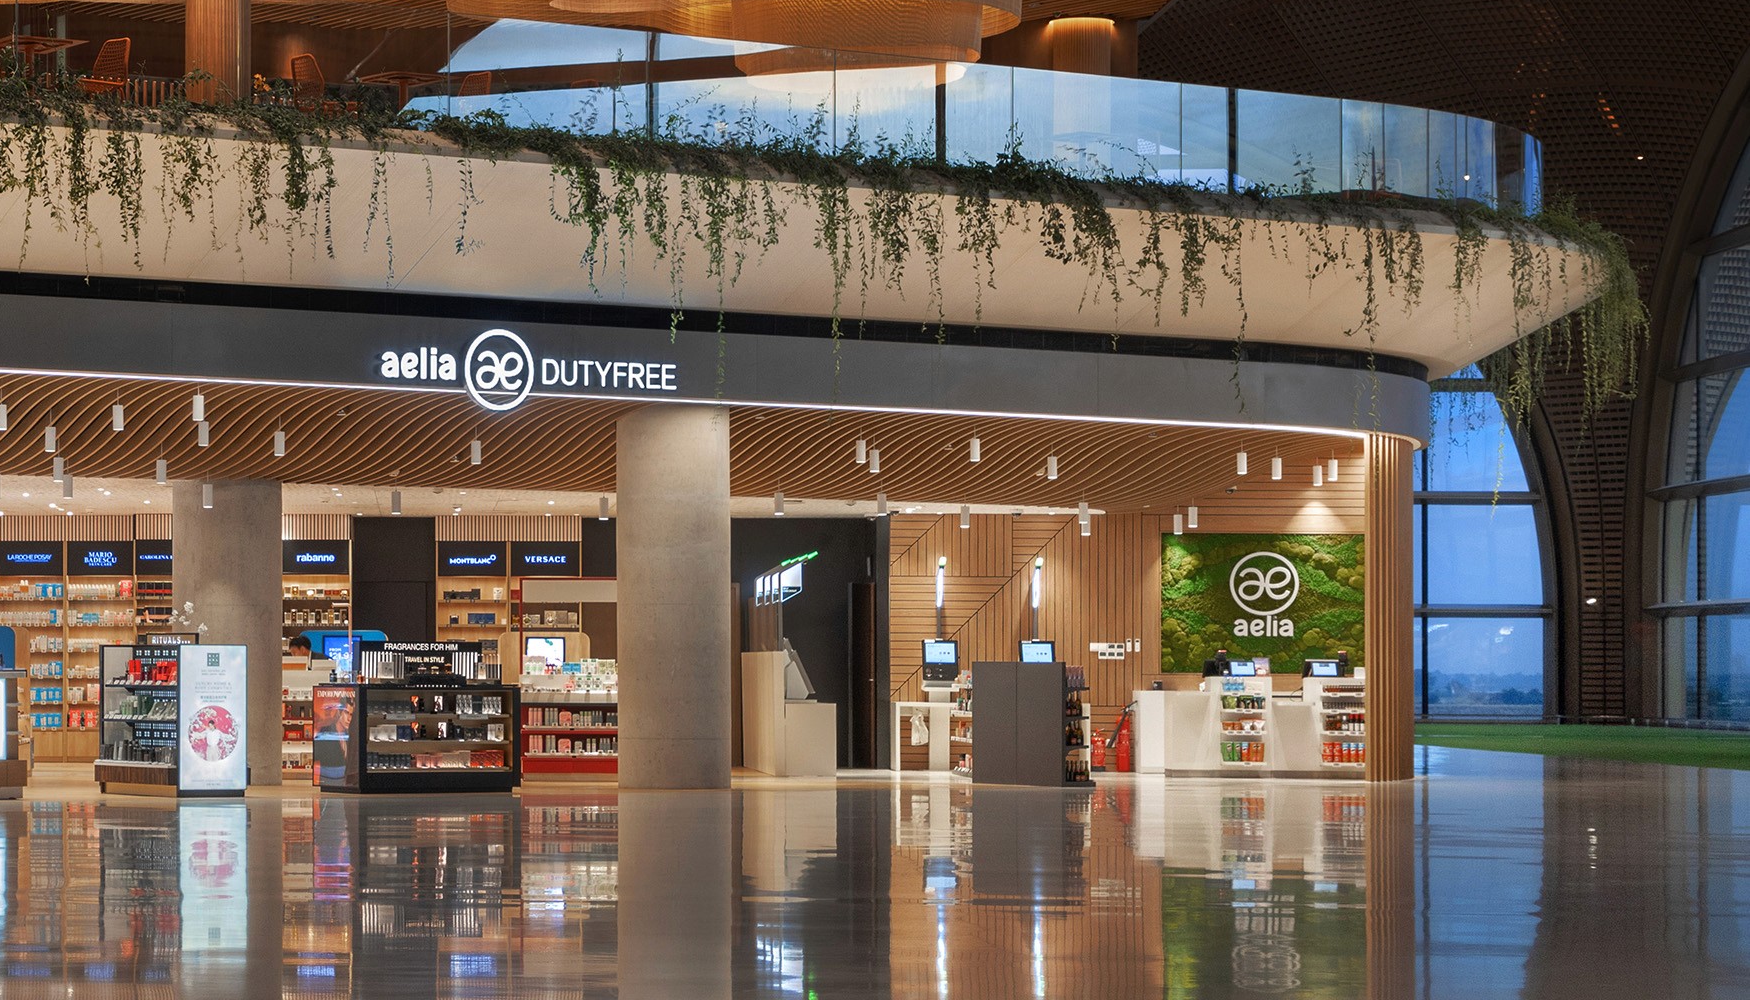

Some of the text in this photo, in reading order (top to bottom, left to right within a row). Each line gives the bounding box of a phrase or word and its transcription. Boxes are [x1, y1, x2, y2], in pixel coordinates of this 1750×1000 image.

[380, 347, 457, 381] aelia
[542, 358, 677, 391] DUTYFREE
[296, 553, 335, 562] rabanne
[1233, 615, 1294, 637] aelia
[384, 643, 458, 651] FRAGRANCES FOR HIM
